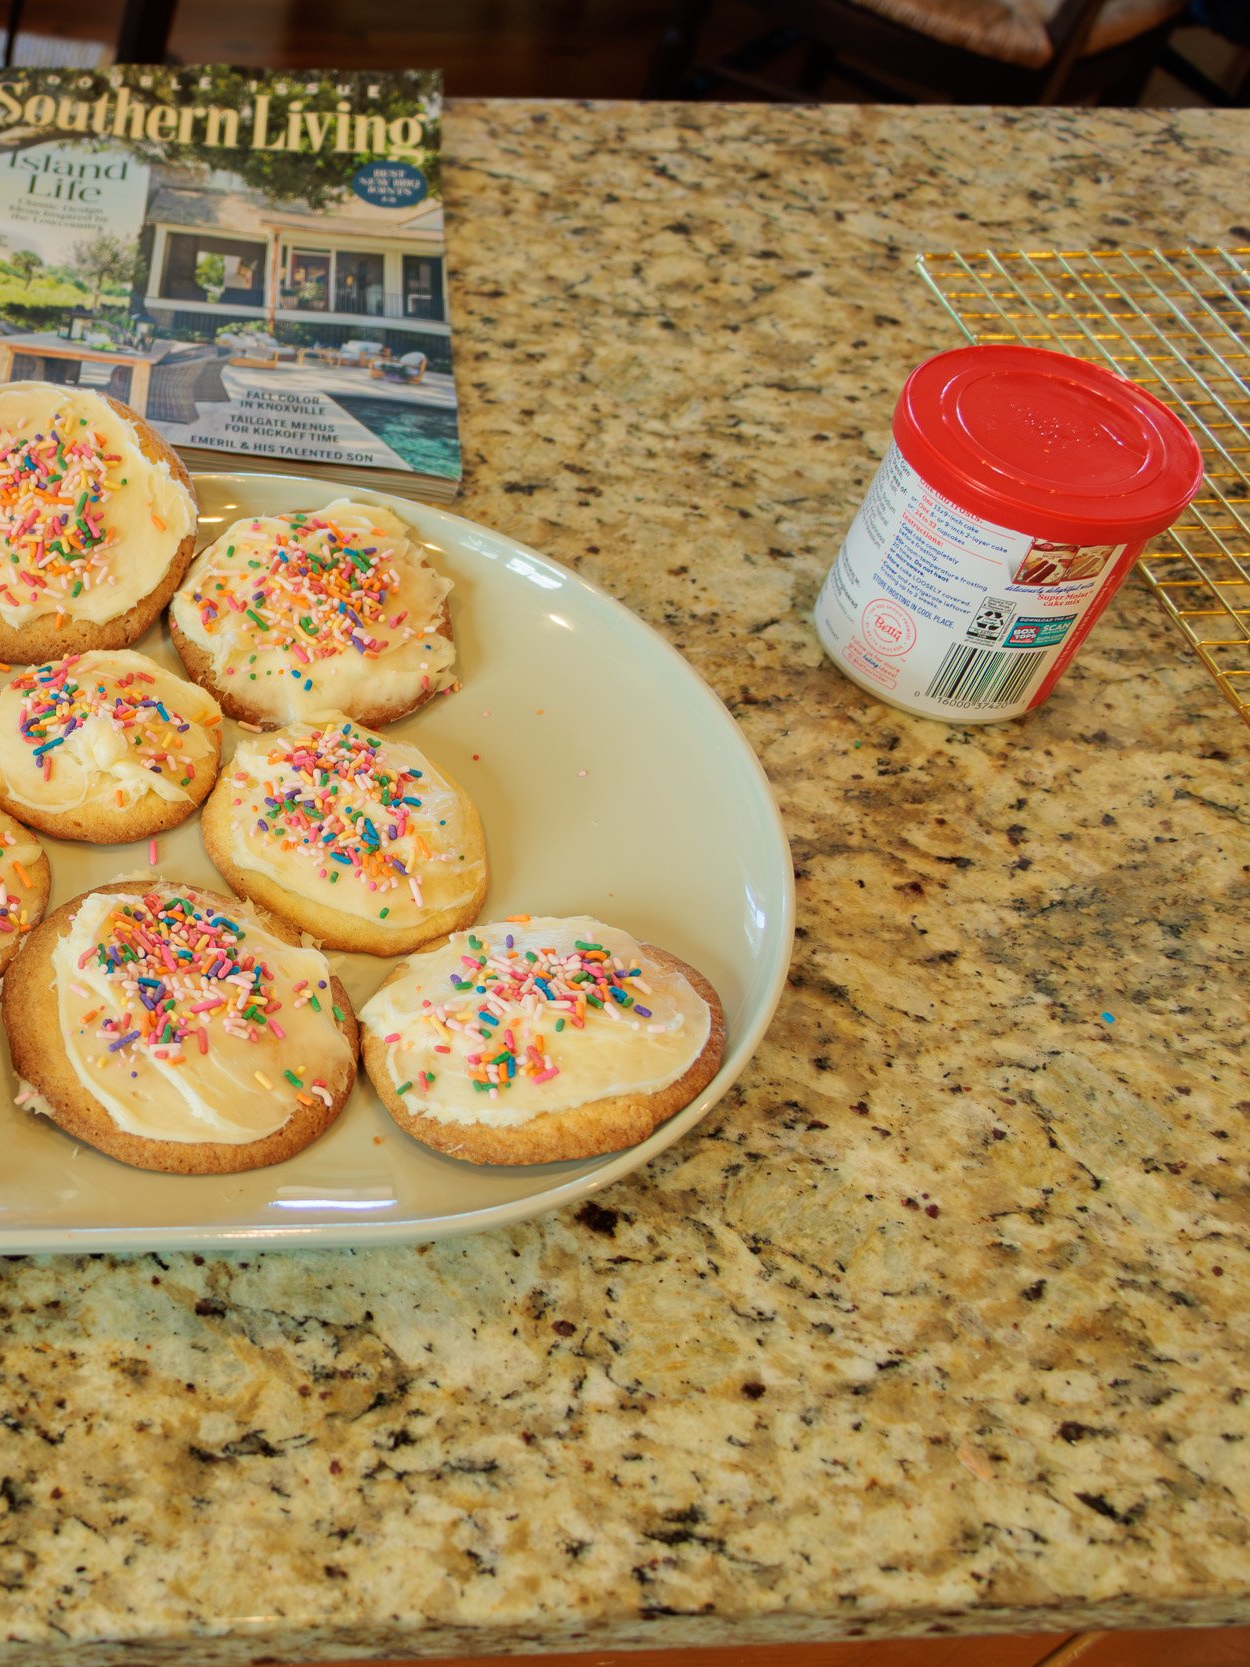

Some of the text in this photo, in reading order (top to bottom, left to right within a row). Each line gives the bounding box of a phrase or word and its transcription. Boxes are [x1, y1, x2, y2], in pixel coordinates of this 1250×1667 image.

[250, 80, 381, 99] ISSUE
[251, 94, 429, 167] Living
[7, 149, 128, 181] Island
[28, 174, 103, 202] Life
[240, 400, 326, 416] IN KNOXVILLE
[246, 390, 320, 405] FALL COLOR
[224, 423, 340, 443] FOR KICKOFF TIME
[230, 414, 336, 433] TAILGATE MENUS
[190, 435, 373, 463] EMERIL & HIS TALENTED SON
[922, 494, 933, 507] One
[963, 522, 979, 534] cake
[898, 528, 915, 545] before
[902, 511, 944, 548] Instructions:
[918, 501, 930, 514] One
[944, 521, 965, 539] 9-inch
[965, 532, 990, 548] 2-layer
[990, 542, 1008, 554] cake
[936, 526, 965, 546] cupcakes
[913, 530, 926, 545] cake
[925, 542, 960, 566] completely
[880, 565, 899, 586] frosting
[904, 543, 959, 580] room-temperature
[960, 576, 989, 592] frosting
[913, 559, 923, 568] Do
[923, 565, 934, 576] not
[933, 571, 949, 583] heat
[883, 560, 897, 575] Cover
[897, 573, 908, 584] and
[907, 581, 943, 605] refrigerate
[943, 600, 971, 615] leftover
[899, 563, 912, 577] cake
[912, 573, 942, 594] LOOSELY
[942, 592, 971, 607] covered.
[872, 572, 887, 590] STORE
[886, 583, 911, 608] FROSTING
[917, 605, 933, 621] COOL
[932, 614, 954, 630] PLACE.
[1043, 599, 1064, 607] cake
[874, 614, 903, 643] Betty
[1013, 627, 1036, 635] BOX
[1043, 622, 1071, 632] SCAN
[936, 696, 971, 709] 16000
[974, 701, 1009, 710] 37420
